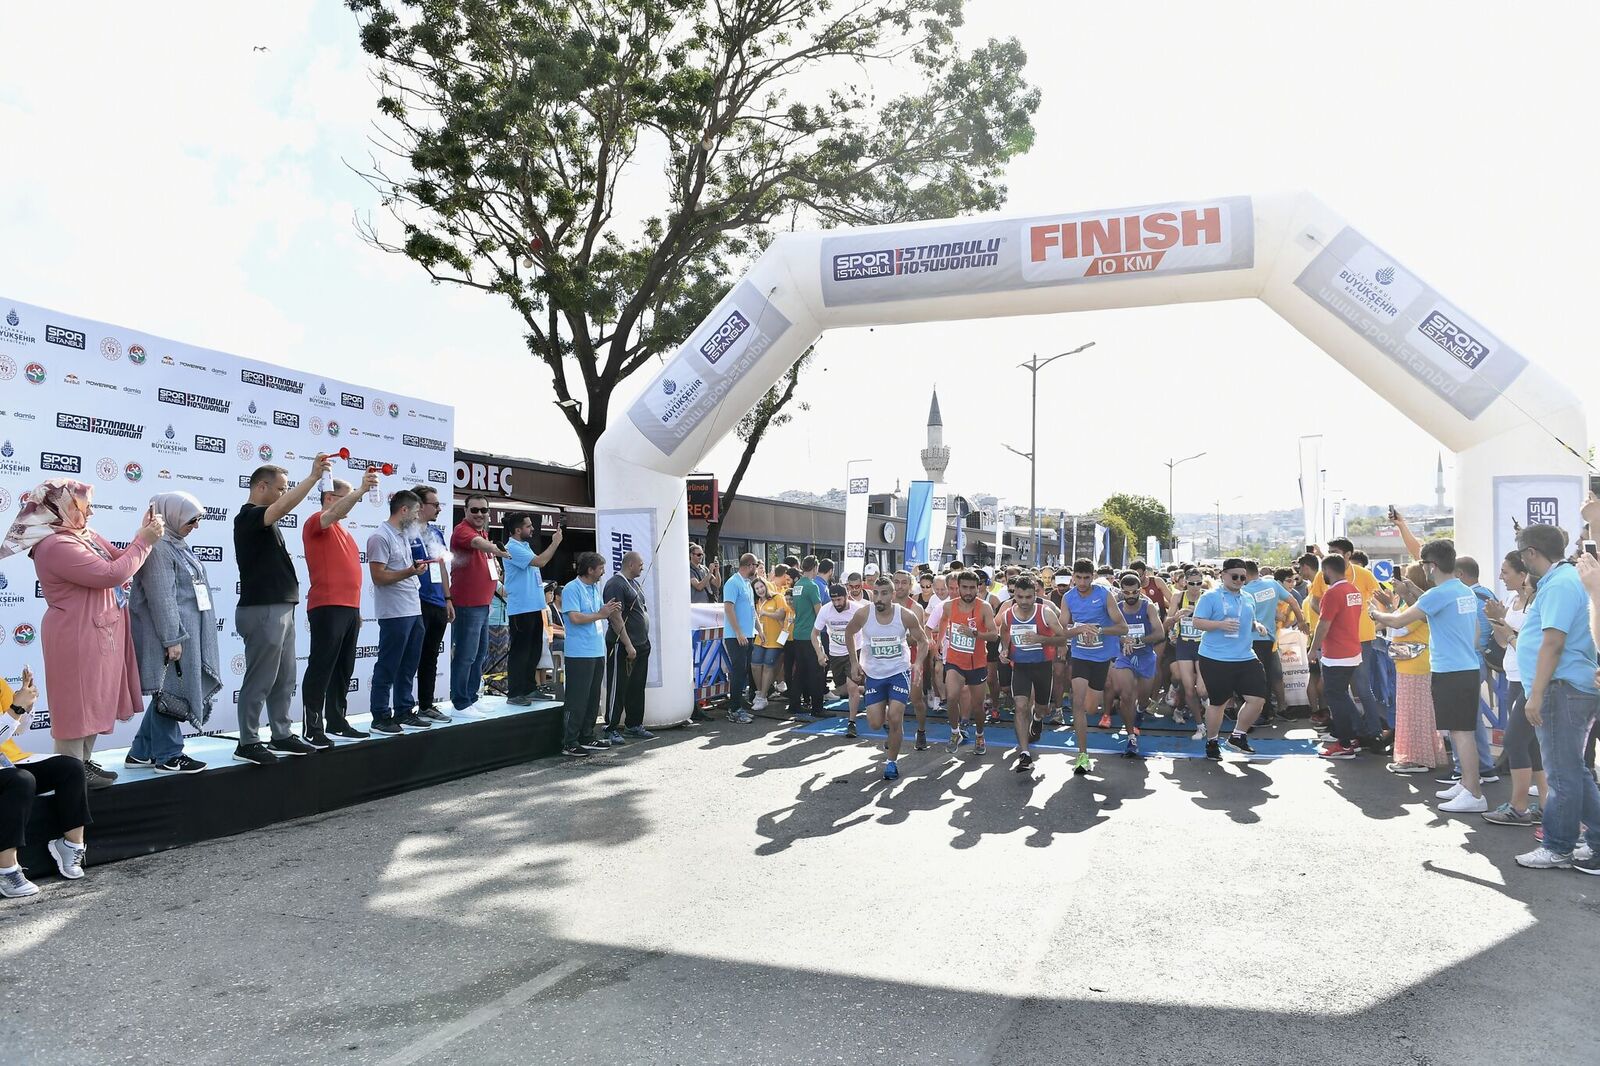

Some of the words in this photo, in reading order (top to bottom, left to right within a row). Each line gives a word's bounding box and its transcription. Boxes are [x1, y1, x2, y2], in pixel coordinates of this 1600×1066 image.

[1030, 207, 1221, 262] FINISH
[836, 252, 889, 269] SPOR
[1097, 258, 1117, 274] 10
[1124, 254, 1152, 271] KM
[1340, 270, 1397, 317] BÜYÜKŞEHİR
[48, 327, 83, 343] SPOR
[704, 315, 741, 355] SPOR
[1429, 314, 1483, 359] SPOR
[160, 389, 184, 401] SPOR
[342, 394, 362, 404] SPOR
[661, 379, 703, 423] BÜYÜKŞEHİR
[58, 414, 89, 425] SPOR
[274, 411, 298, 422] SPOR
[196, 436, 224, 447] SPOR
[43, 454, 79, 466] SPOR
[453, 460, 513, 497] OREÇ
[193, 547, 221, 556] SPOR
[952, 633, 973, 647] 1386
